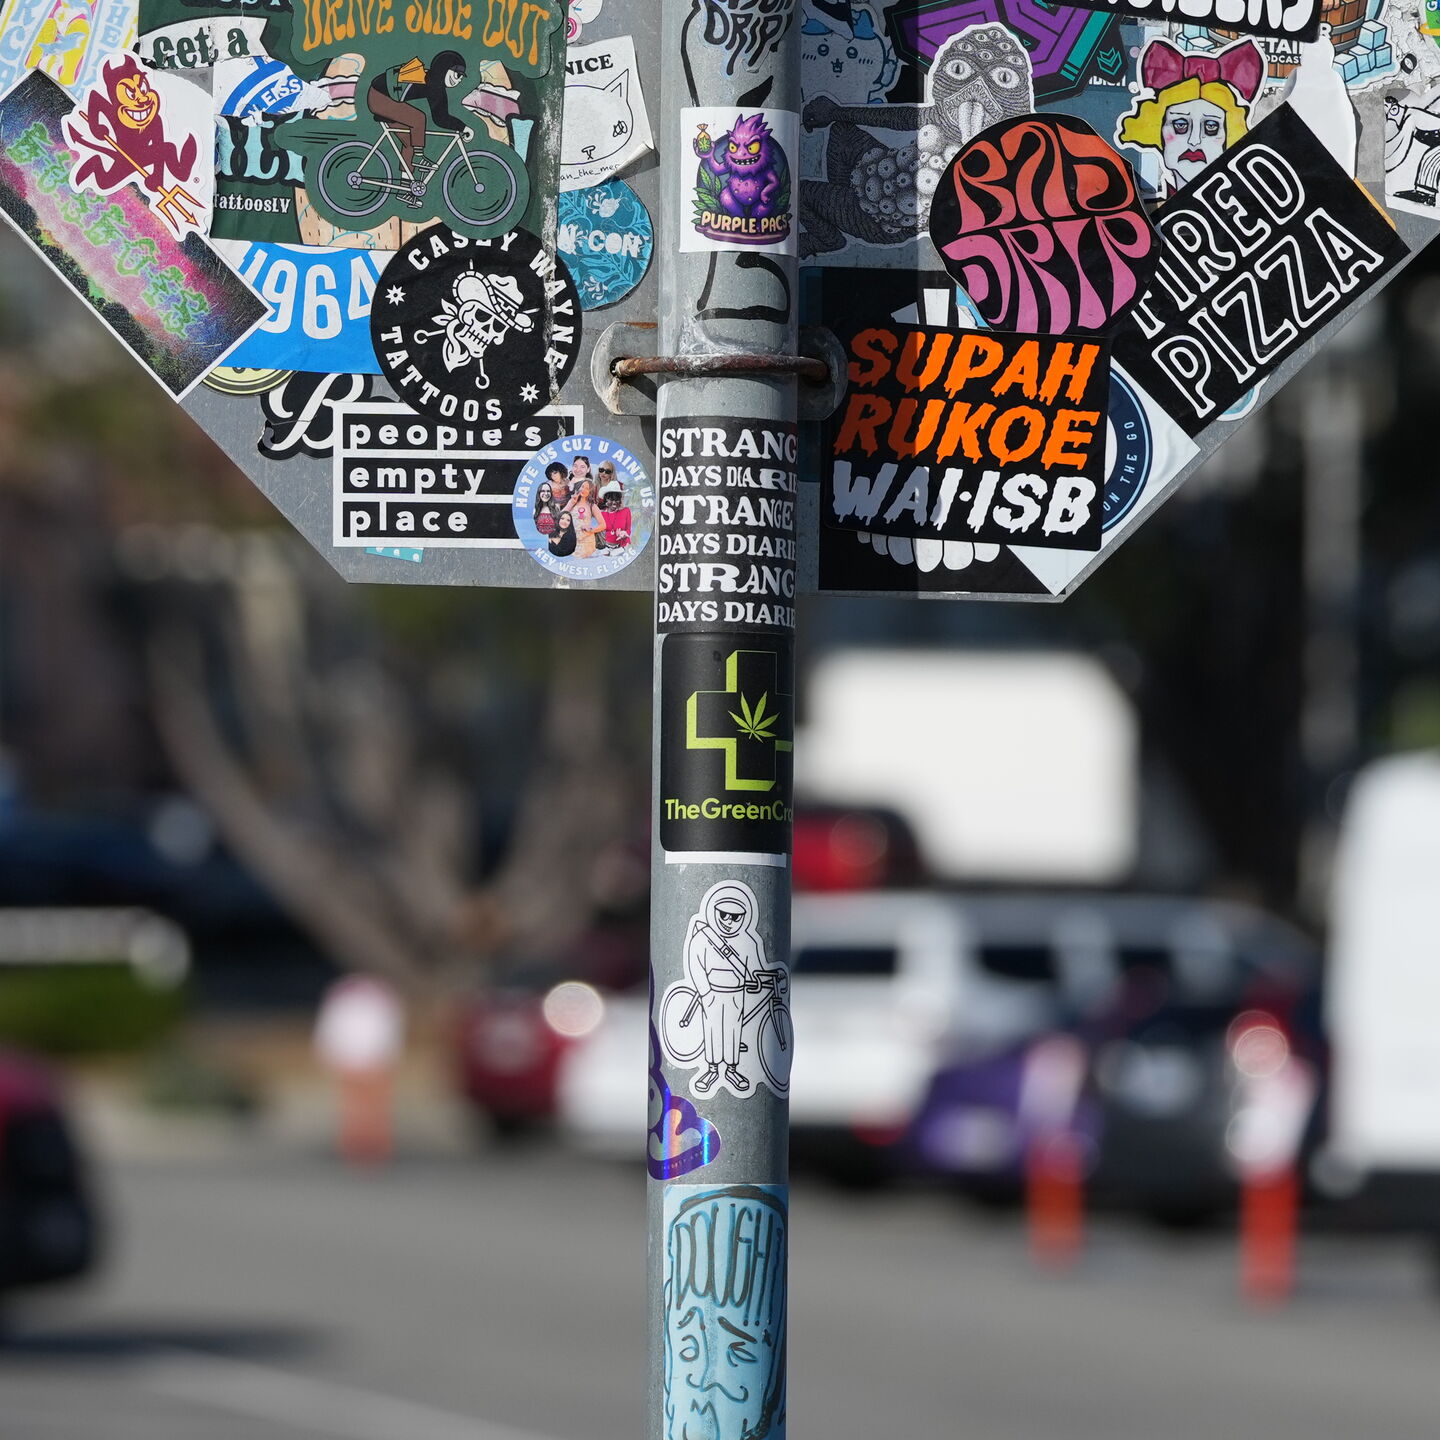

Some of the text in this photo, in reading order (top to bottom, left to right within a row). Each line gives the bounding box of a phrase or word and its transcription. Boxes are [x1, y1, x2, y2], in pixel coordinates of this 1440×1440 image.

[227, 26, 251, 56] a
[700, 210, 791, 235] PURPLE PACS
[940, 210, 1153, 337] DRIP
[407, 230, 519, 272] CASEY
[528, 249, 576, 371] WAYNE
[1150, 206, 1385, 419] PIZZA
[380, 325, 504, 423] TATTOOS
[846, 328, 1101, 407] SUPAH
[661, 426, 797, 464] STRANG
[832, 392, 1101, 471] RUKOE
[1123, 421, 1138, 441] GO
[348, 464, 487, 497] empty
[515, 438, 655, 508] HATE US CUZ U AINT US
[660, 465, 797, 495] DAYS DIARIE
[1120, 453, 1138, 485] THE
[348, 501, 470, 539] place
[660, 494, 794, 532] STRANGE
[534, 547, 557, 567] KEY
[596, 564, 610, 574] FL
[659, 533, 796, 561] DAYS DIARIE
[658, 561, 796, 599] STRANG
[658, 601, 796, 629] DAYS DIARIE
